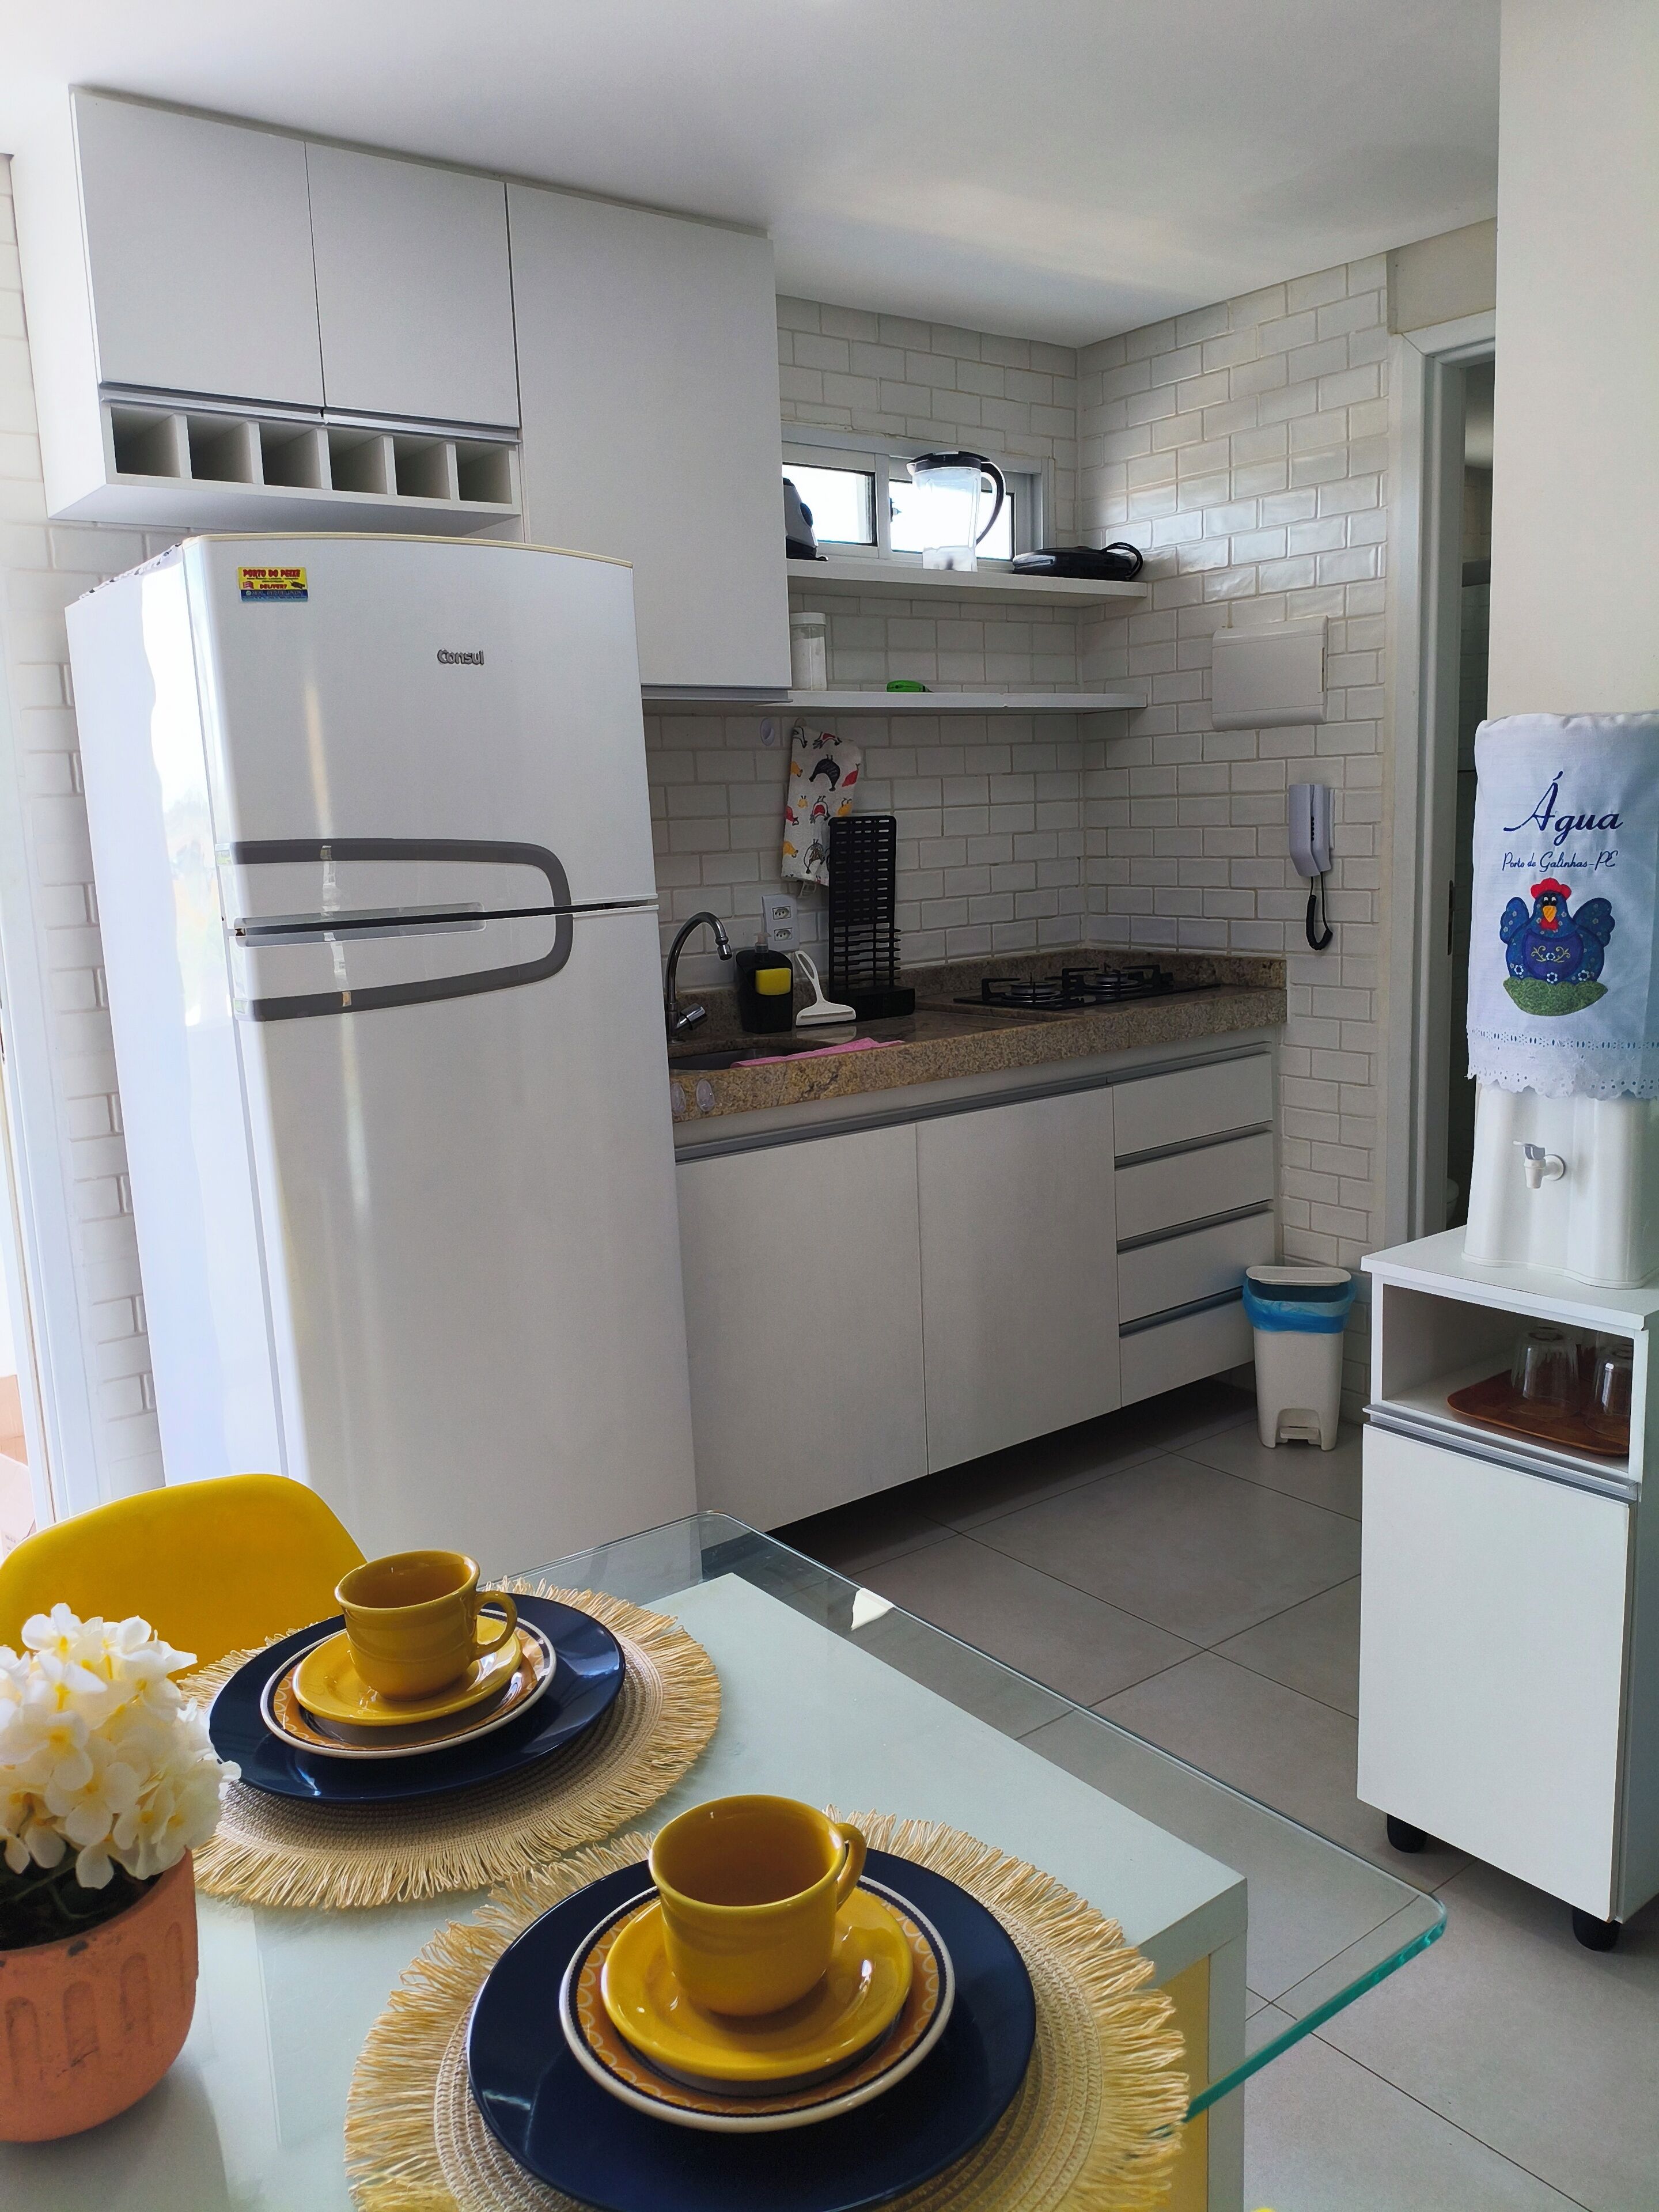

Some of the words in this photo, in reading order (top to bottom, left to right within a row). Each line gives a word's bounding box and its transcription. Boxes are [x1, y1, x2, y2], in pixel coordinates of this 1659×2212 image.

[243, 569, 266, 577] PORTO
[268, 569, 278, 577] DO
[437, 649, 484, 665] Consul
[1503, 771, 1623, 846] Água
[1502, 852, 1525, 871] Porto
[1527, 853, 1536, 868] de
